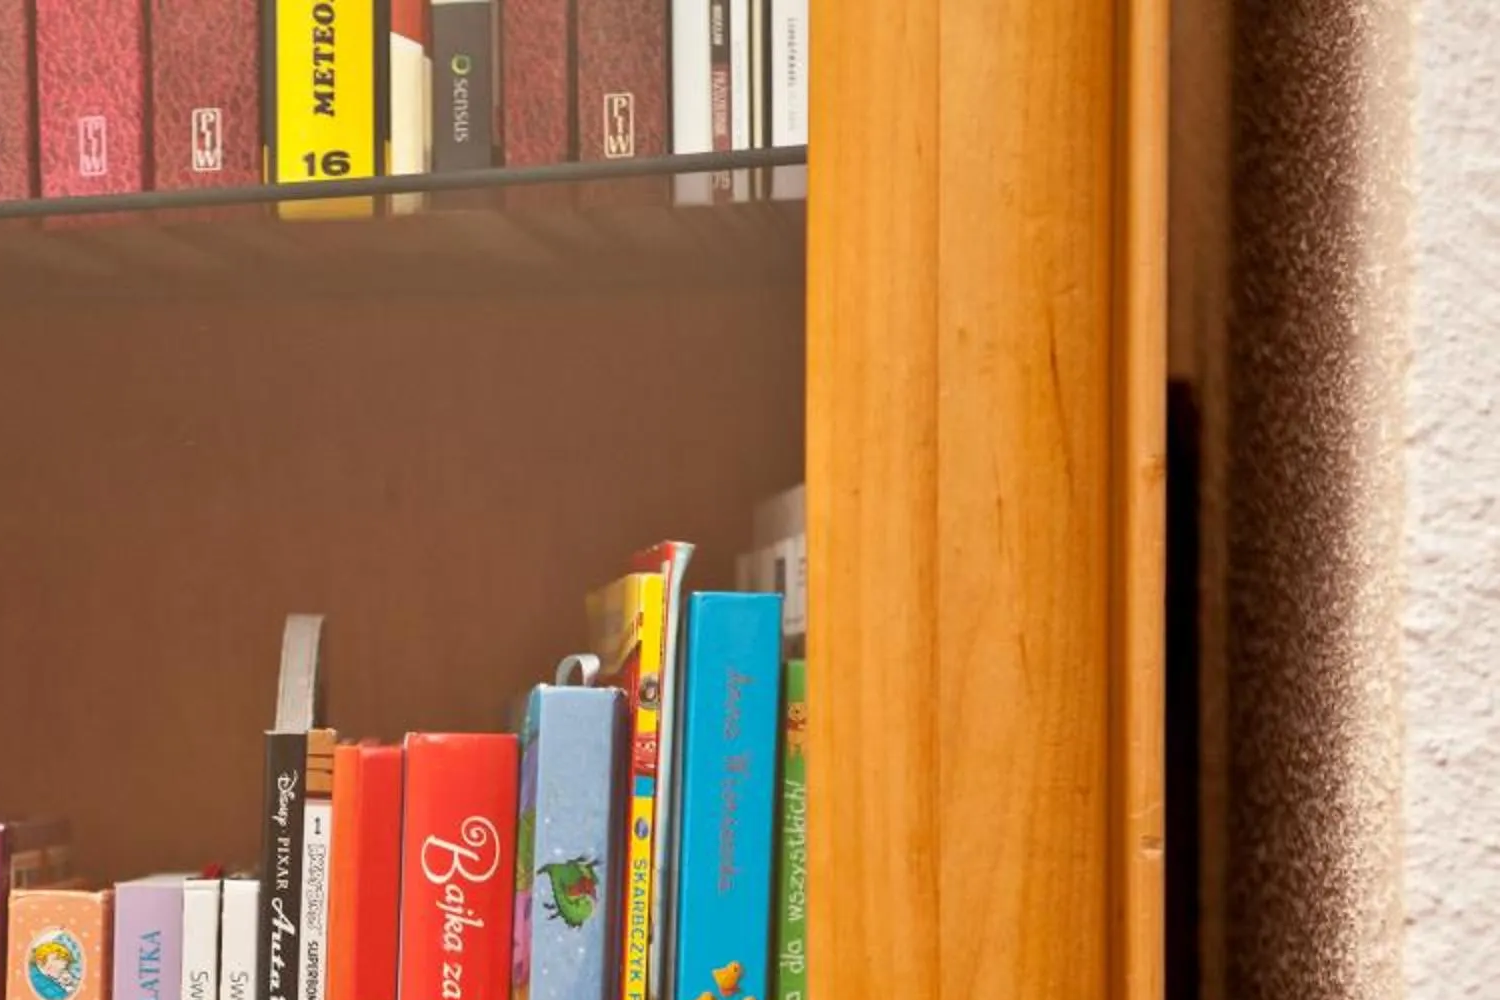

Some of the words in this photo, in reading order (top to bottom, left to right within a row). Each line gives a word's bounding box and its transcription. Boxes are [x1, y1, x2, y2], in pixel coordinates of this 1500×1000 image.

[312, 0, 336, 117] METEO
[303, 150, 351, 177] 16
[272, 770, 299, 827] Disney
[275, 838, 292, 890] PIXAR
[421, 815, 500, 953] Bajka
[270, 898, 296, 991] Auta
[628, 860, 647, 983] SKARBCZYK
[442, 962, 463, 1000] za
[778, 938, 806, 975] dla
